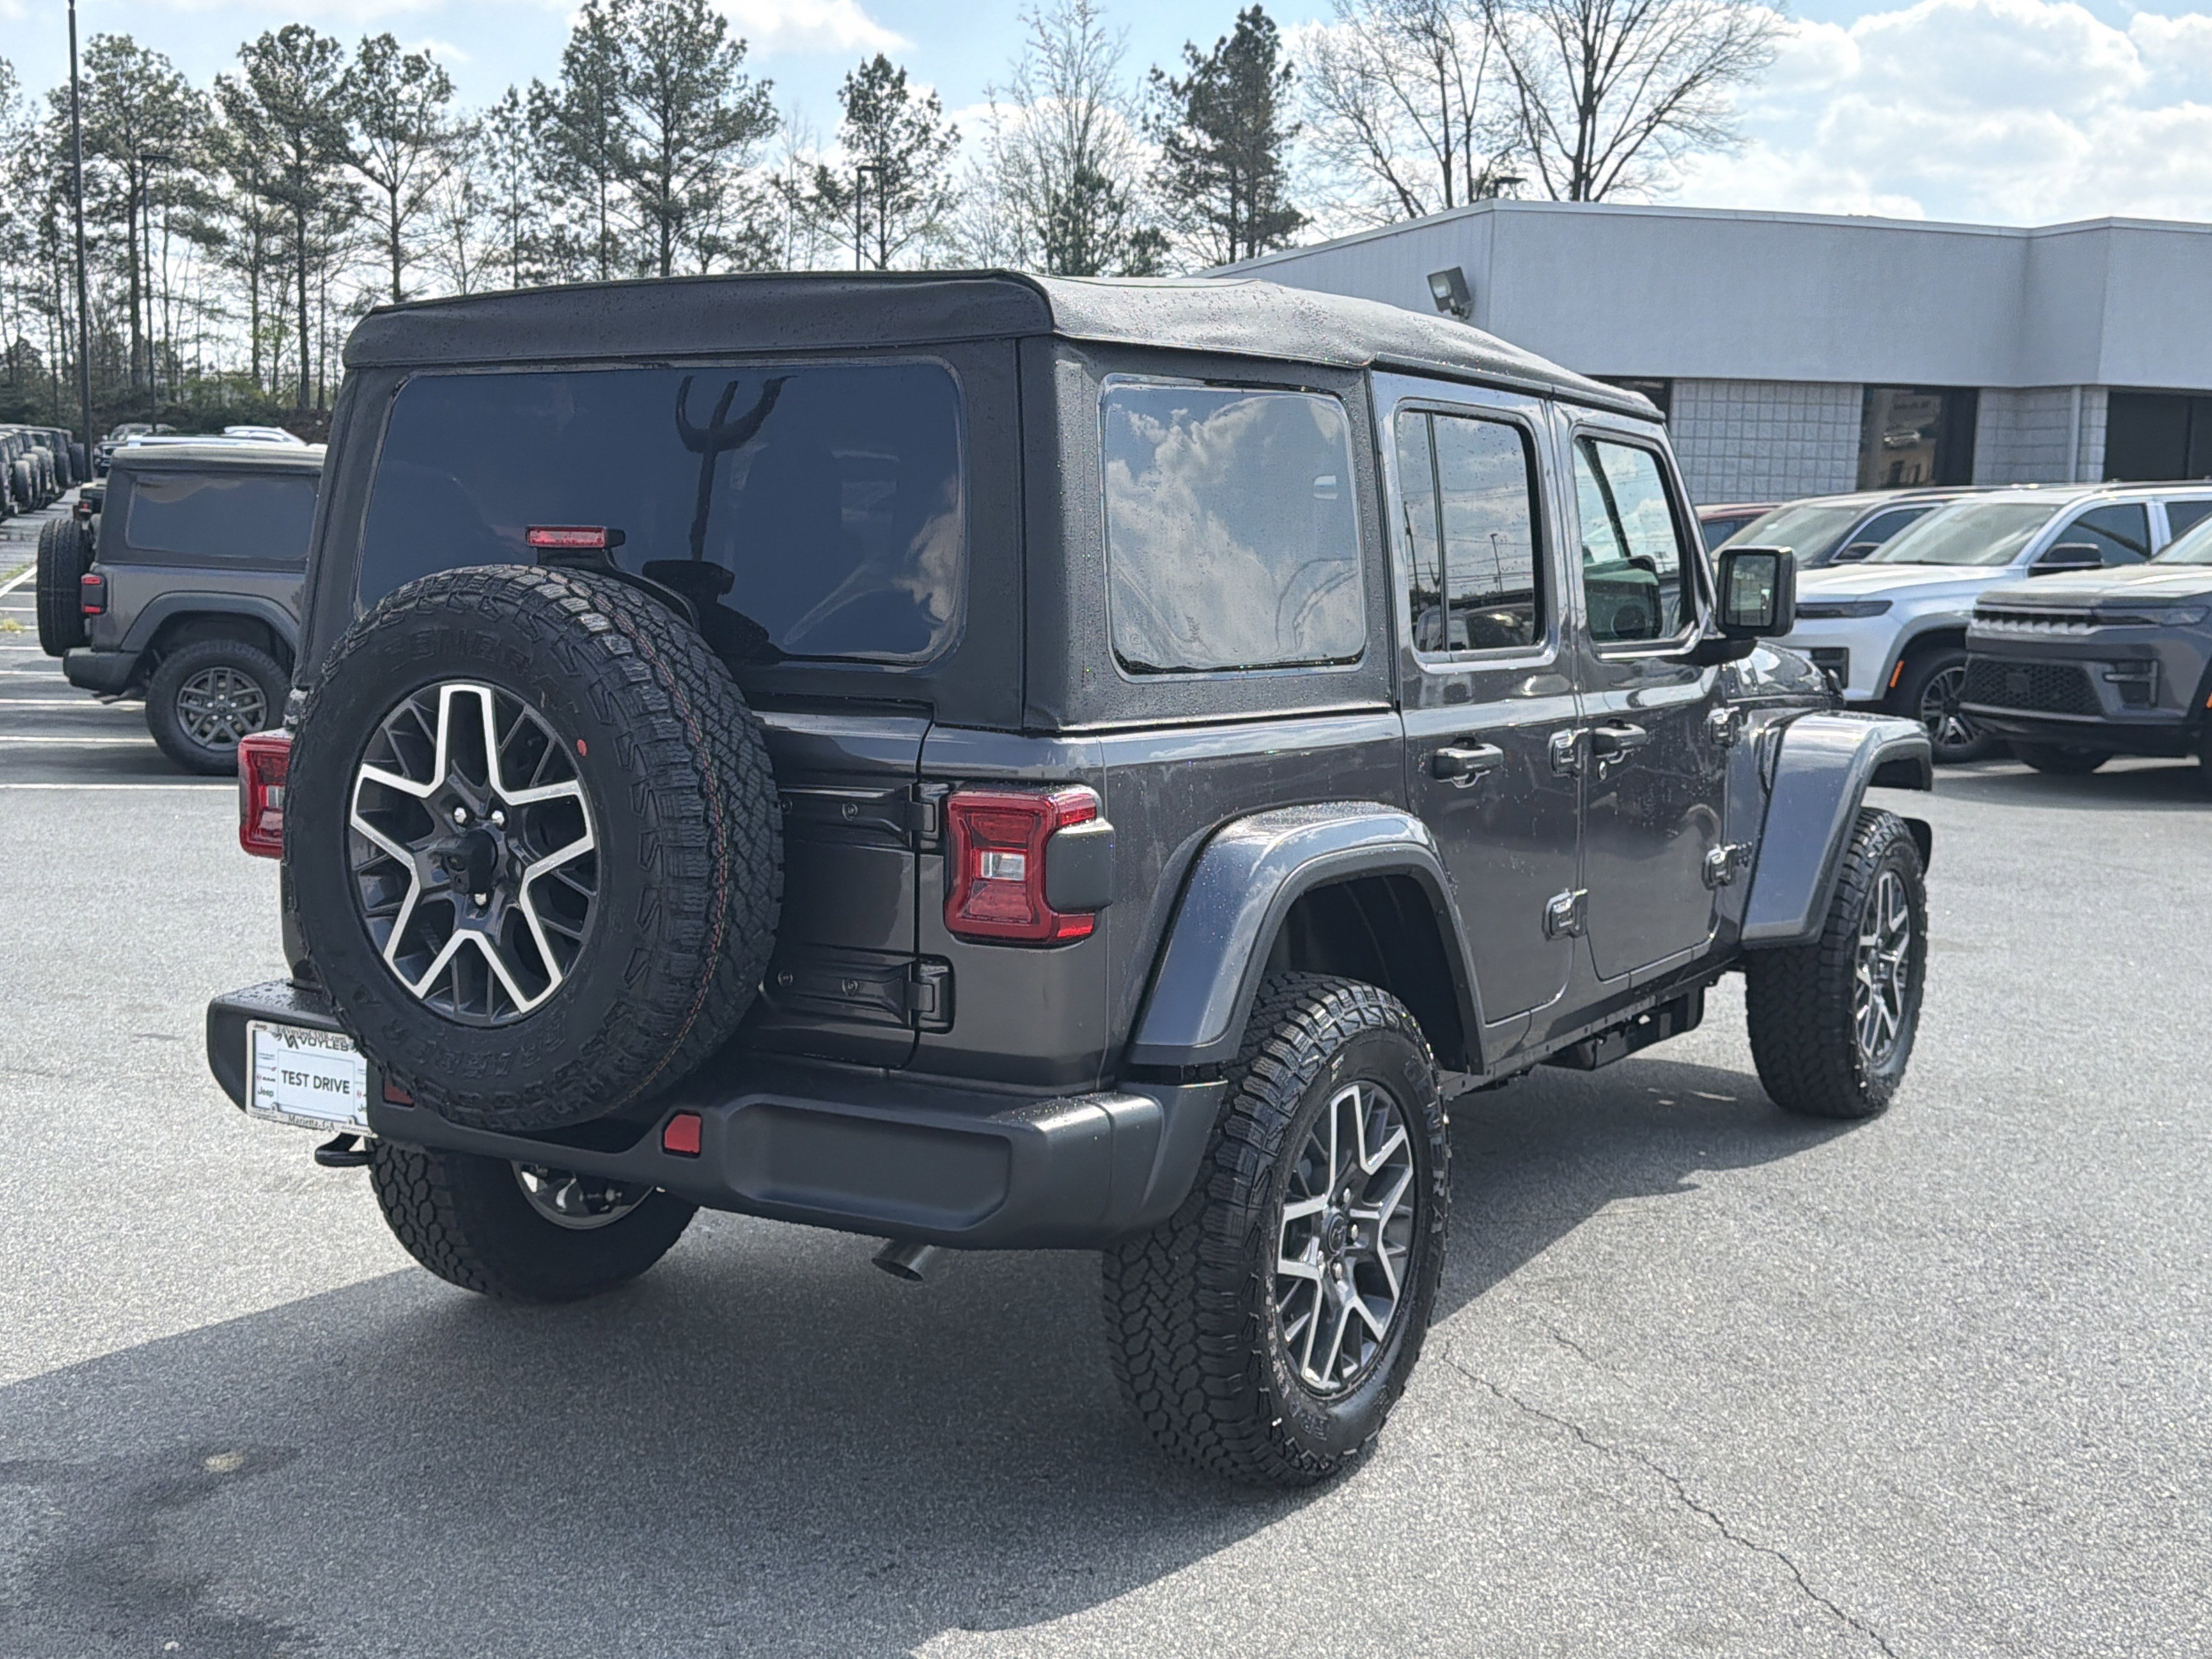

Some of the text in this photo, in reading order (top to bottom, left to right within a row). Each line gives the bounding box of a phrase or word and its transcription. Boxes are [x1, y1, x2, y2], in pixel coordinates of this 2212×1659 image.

[281, 1069, 351, 1095] TEST DRIVE
[257, 1086, 274, 1098] Jeep
